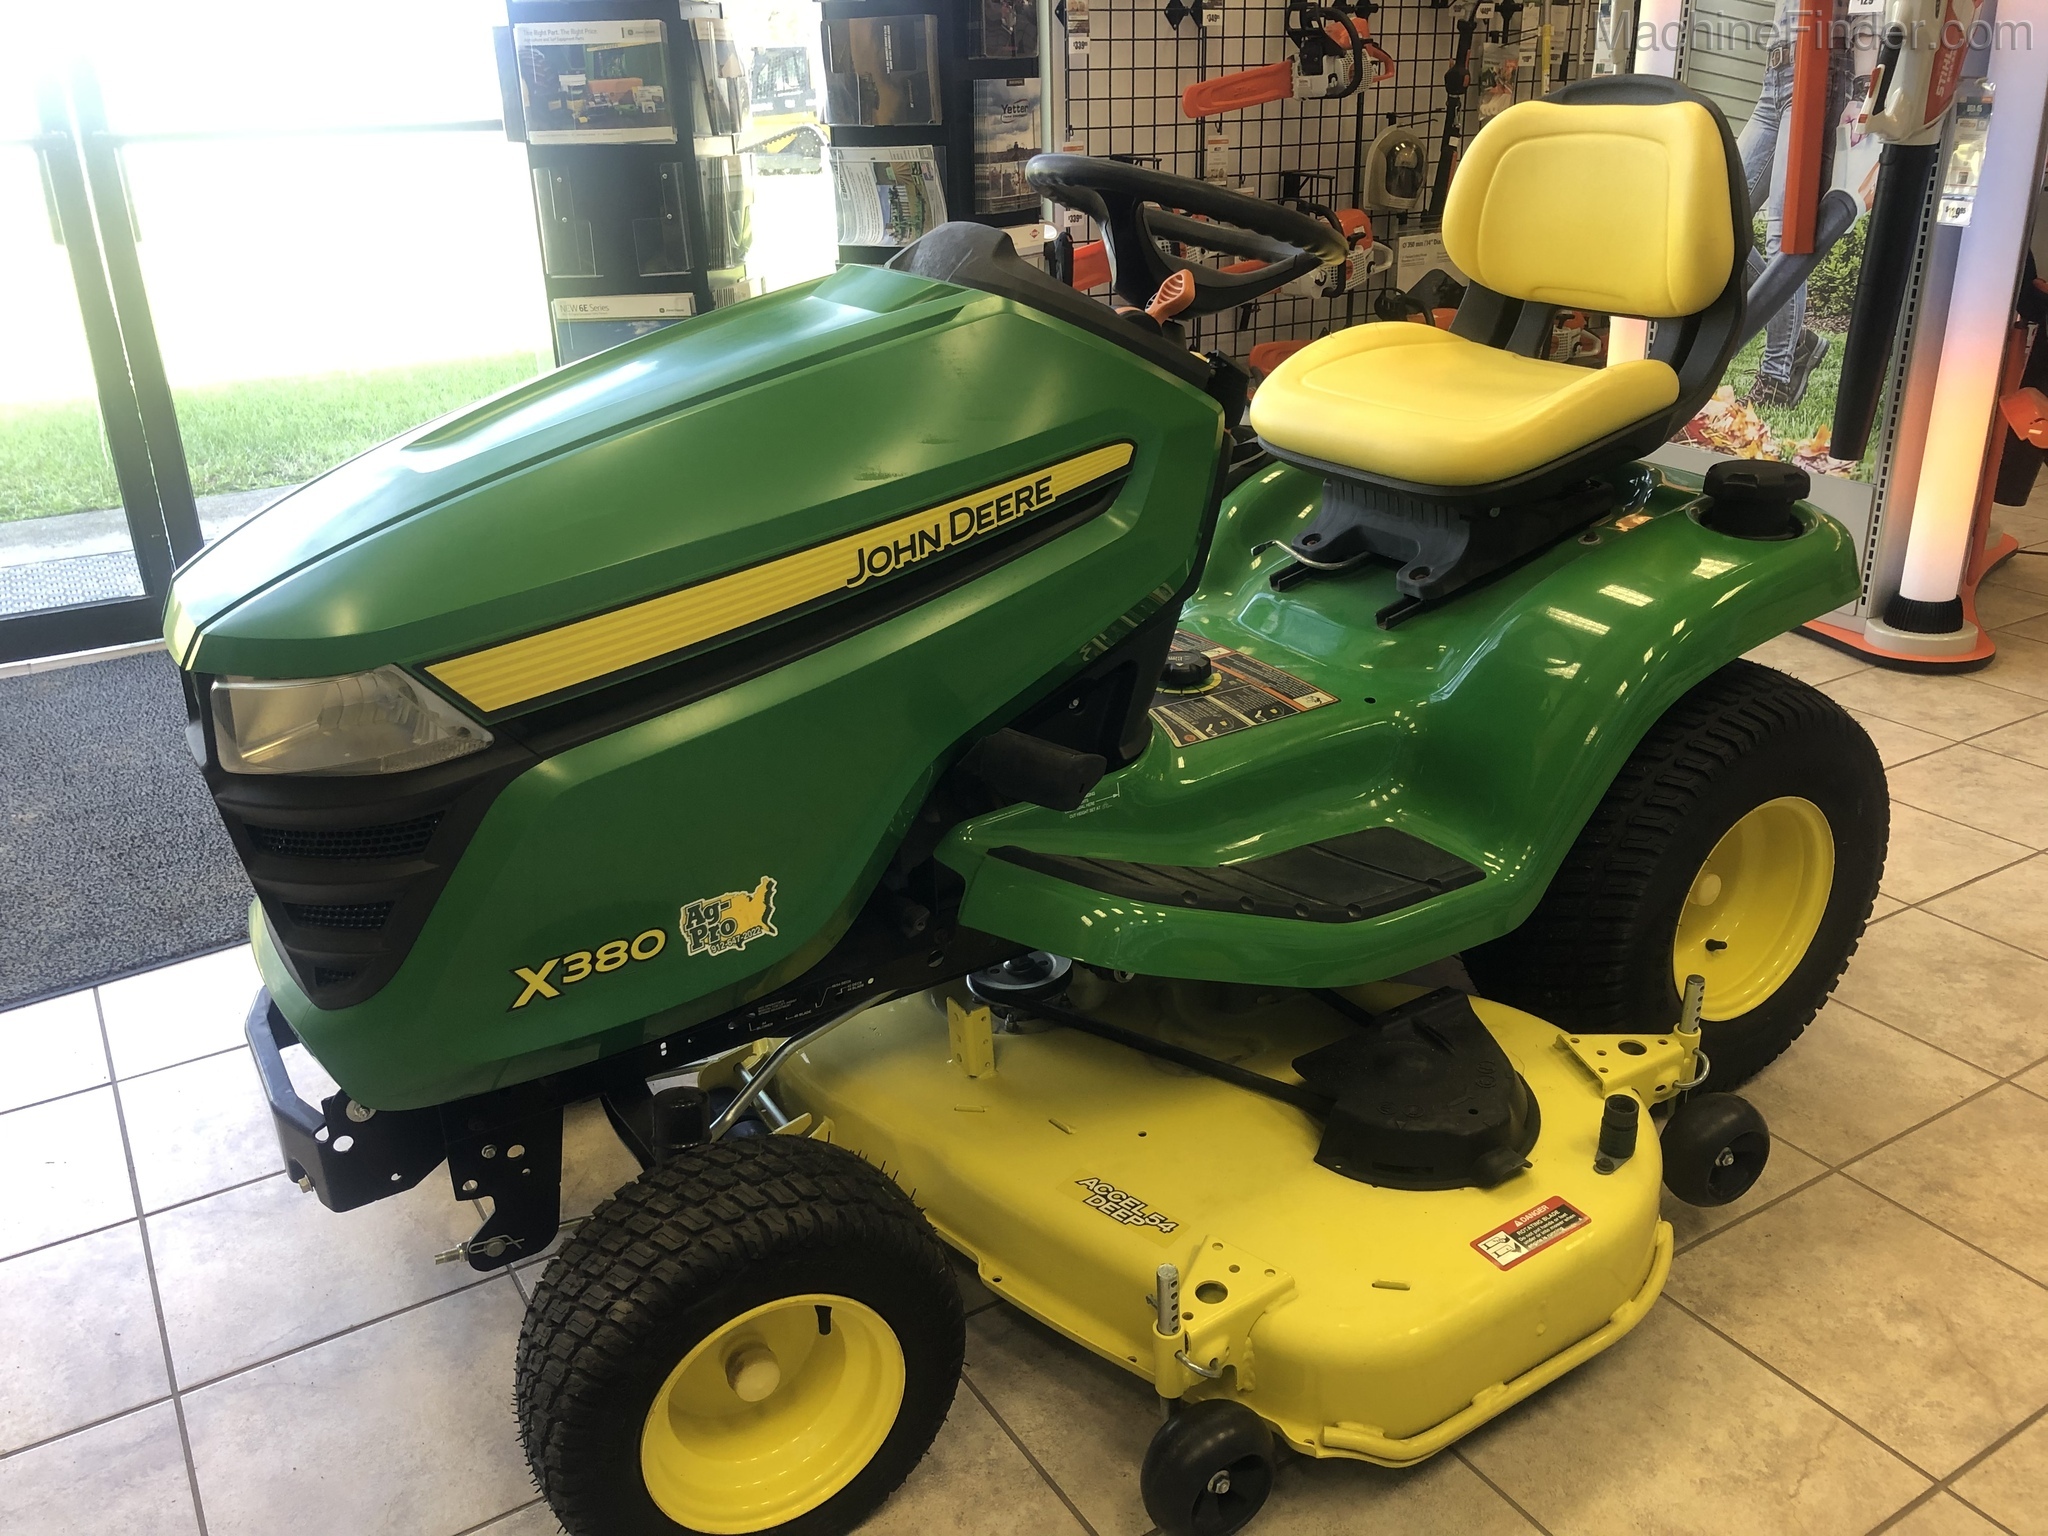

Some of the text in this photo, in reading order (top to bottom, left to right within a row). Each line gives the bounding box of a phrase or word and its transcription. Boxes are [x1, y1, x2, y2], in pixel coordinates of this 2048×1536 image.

[534, 29, 546, 37] Right
[571, 28, 583, 36] Right
[1936, 49, 1955, 97] STIHL
[1001, 104, 1028, 114] Yetter
[560, 304, 609, 312] NEW 6E Series
[846, 475, 1055, 587] JOHN DEERE
[685, 902, 730, 929] Ag-
[689, 919, 737, 950] Pro
[710, 927, 762, 953] 912-647-2022
[508, 927, 668, 1011] X380
[1074, 1177, 1179, 1234] ACCEL 54
[1082, 1194, 1146, 1226] DEEP
[1520, 1205, 1549, 1222] DANGER
[1516, 1210, 1560, 1236] ROTATING BLADE
